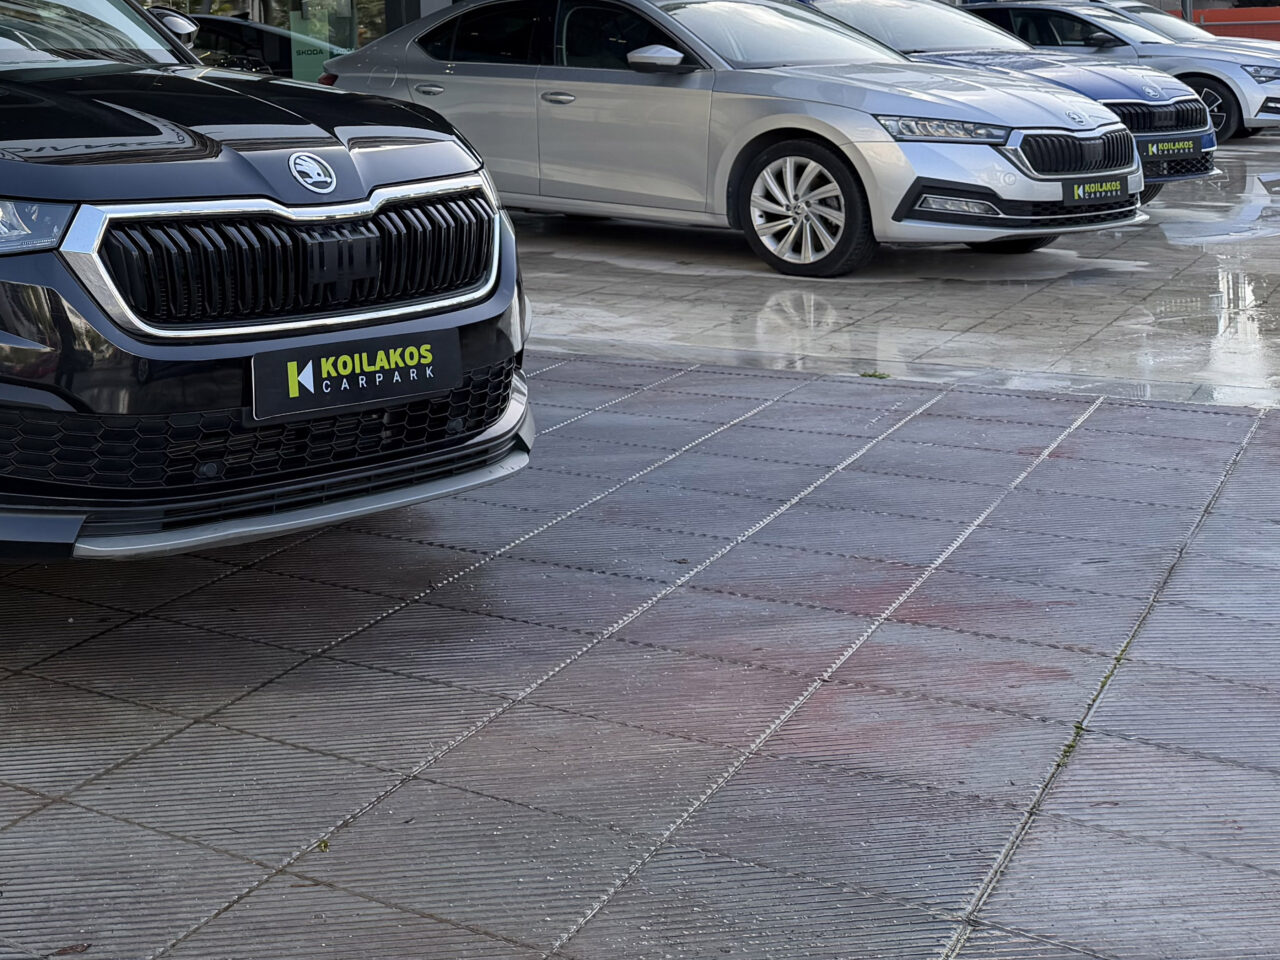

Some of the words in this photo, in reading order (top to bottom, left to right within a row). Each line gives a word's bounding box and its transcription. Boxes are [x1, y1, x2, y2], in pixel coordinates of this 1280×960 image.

[1158, 141, 1193, 151] KOILAKOS
[1084, 181, 1121, 193] KOILAKOS
[321, 344, 433, 378] KOILAKOS
[322, 366, 434, 393] CARPARK
